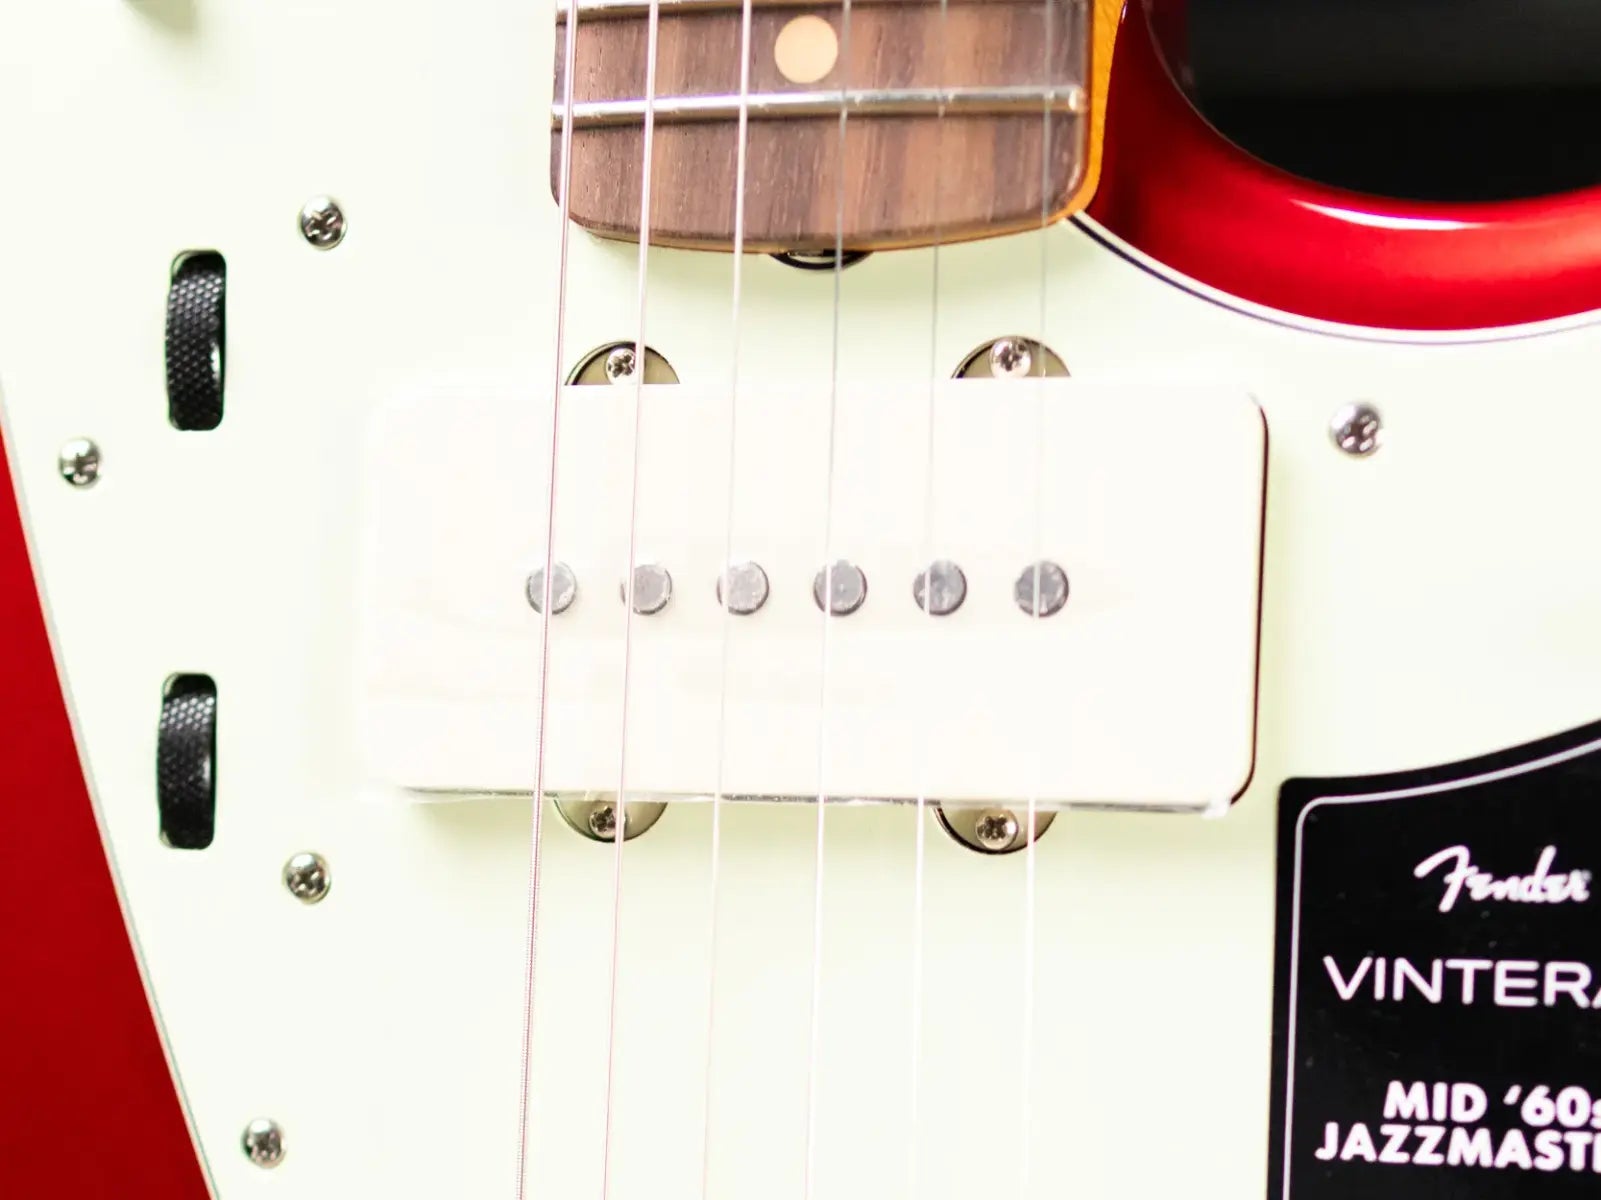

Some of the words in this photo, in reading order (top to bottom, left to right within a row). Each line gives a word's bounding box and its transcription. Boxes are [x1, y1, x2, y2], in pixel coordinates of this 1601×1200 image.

[1414, 846, 1590, 912] Fender
[1323, 956, 1601, 1008] VINTER
[1383, 1081, 1487, 1122] MID
